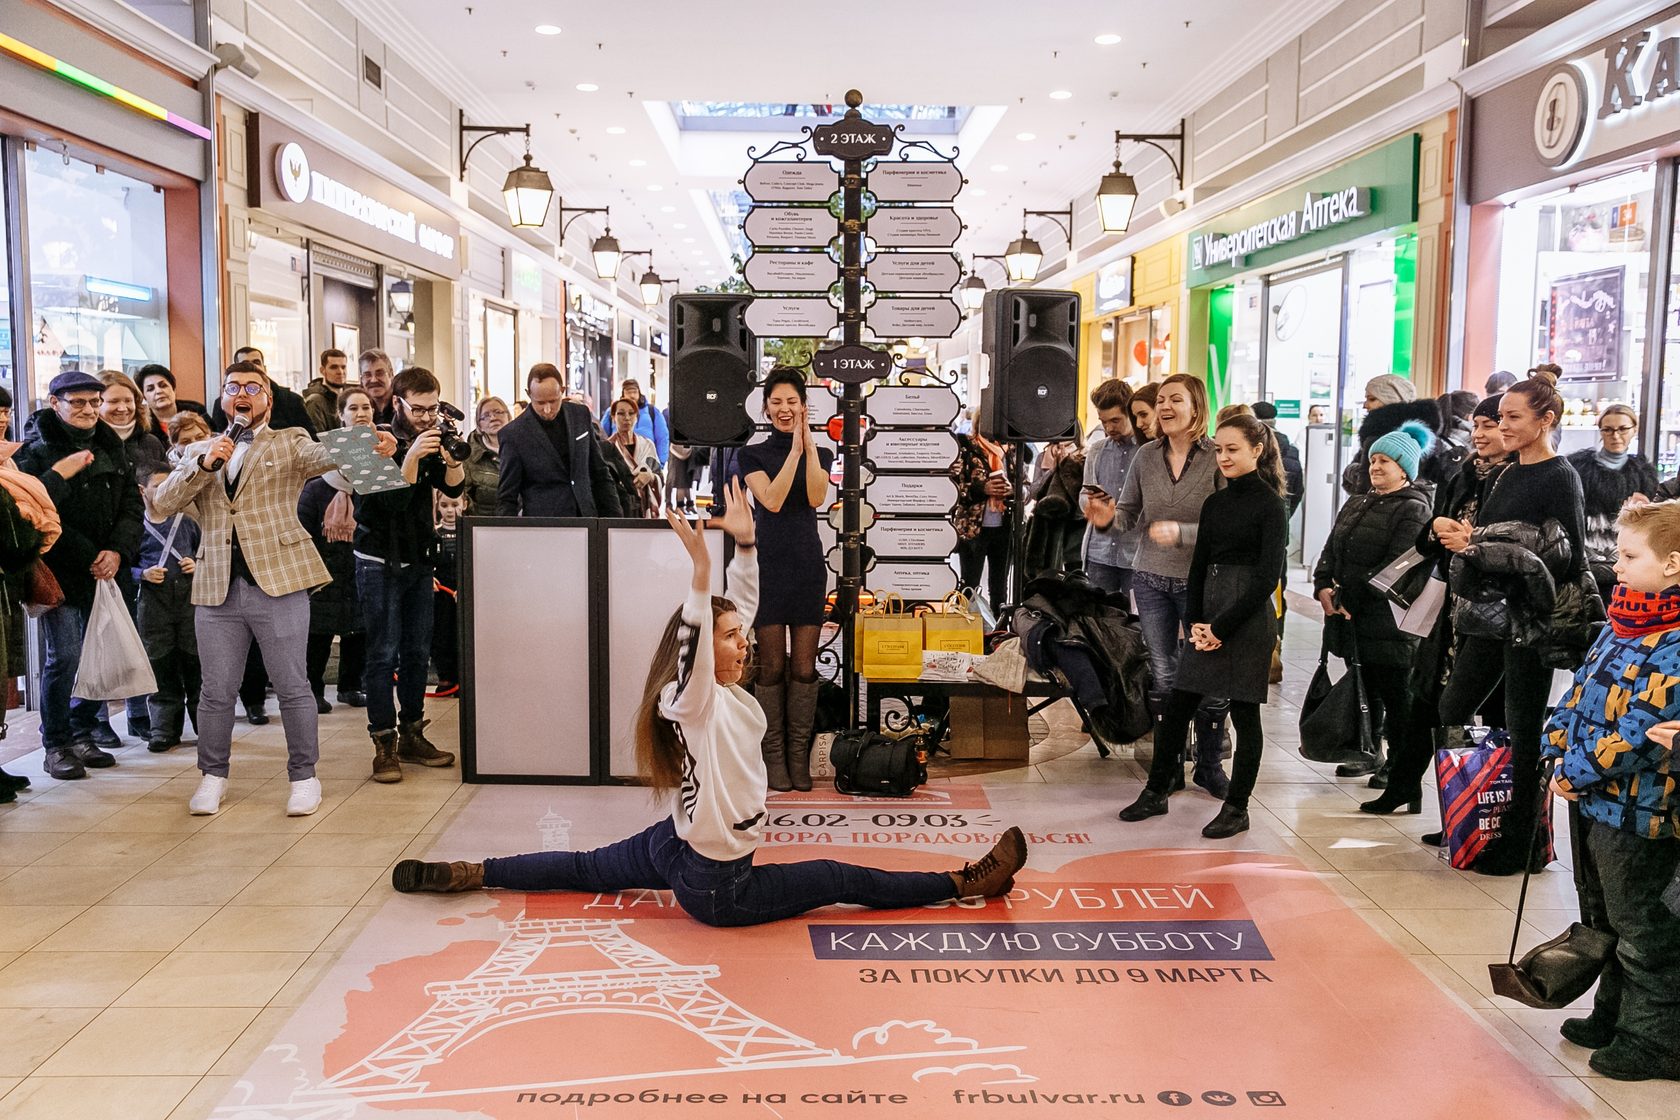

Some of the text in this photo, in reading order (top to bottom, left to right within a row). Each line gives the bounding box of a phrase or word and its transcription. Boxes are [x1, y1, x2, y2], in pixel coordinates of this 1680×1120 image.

[831, 133, 877, 144] 2 ЭТАЖ
[1204, 186, 1359, 268] Университетская Аптека
[833, 359, 876, 370] 1 ЭТАЖ
[818, 734, 827, 777] CARPISA
[1478, 791, 1495, 804] LIFE
[1496, 790, 1505, 803] IS
[1479, 818, 1490, 830] BE
[1480, 832, 1502, 840] DRESS
[1003, 884, 1215, 910] РУБЛЕЙ
[829, 932, 1244, 954] КАЖДУЮ СУББОТУ
[859, 968, 1273, 984] ЗА ПОКУПКИ ДО 9 МАРТА
[517, 1089, 907, 1106] подробнее на сайте
[953, 1090, 1145, 1103] frbulvar.ru
